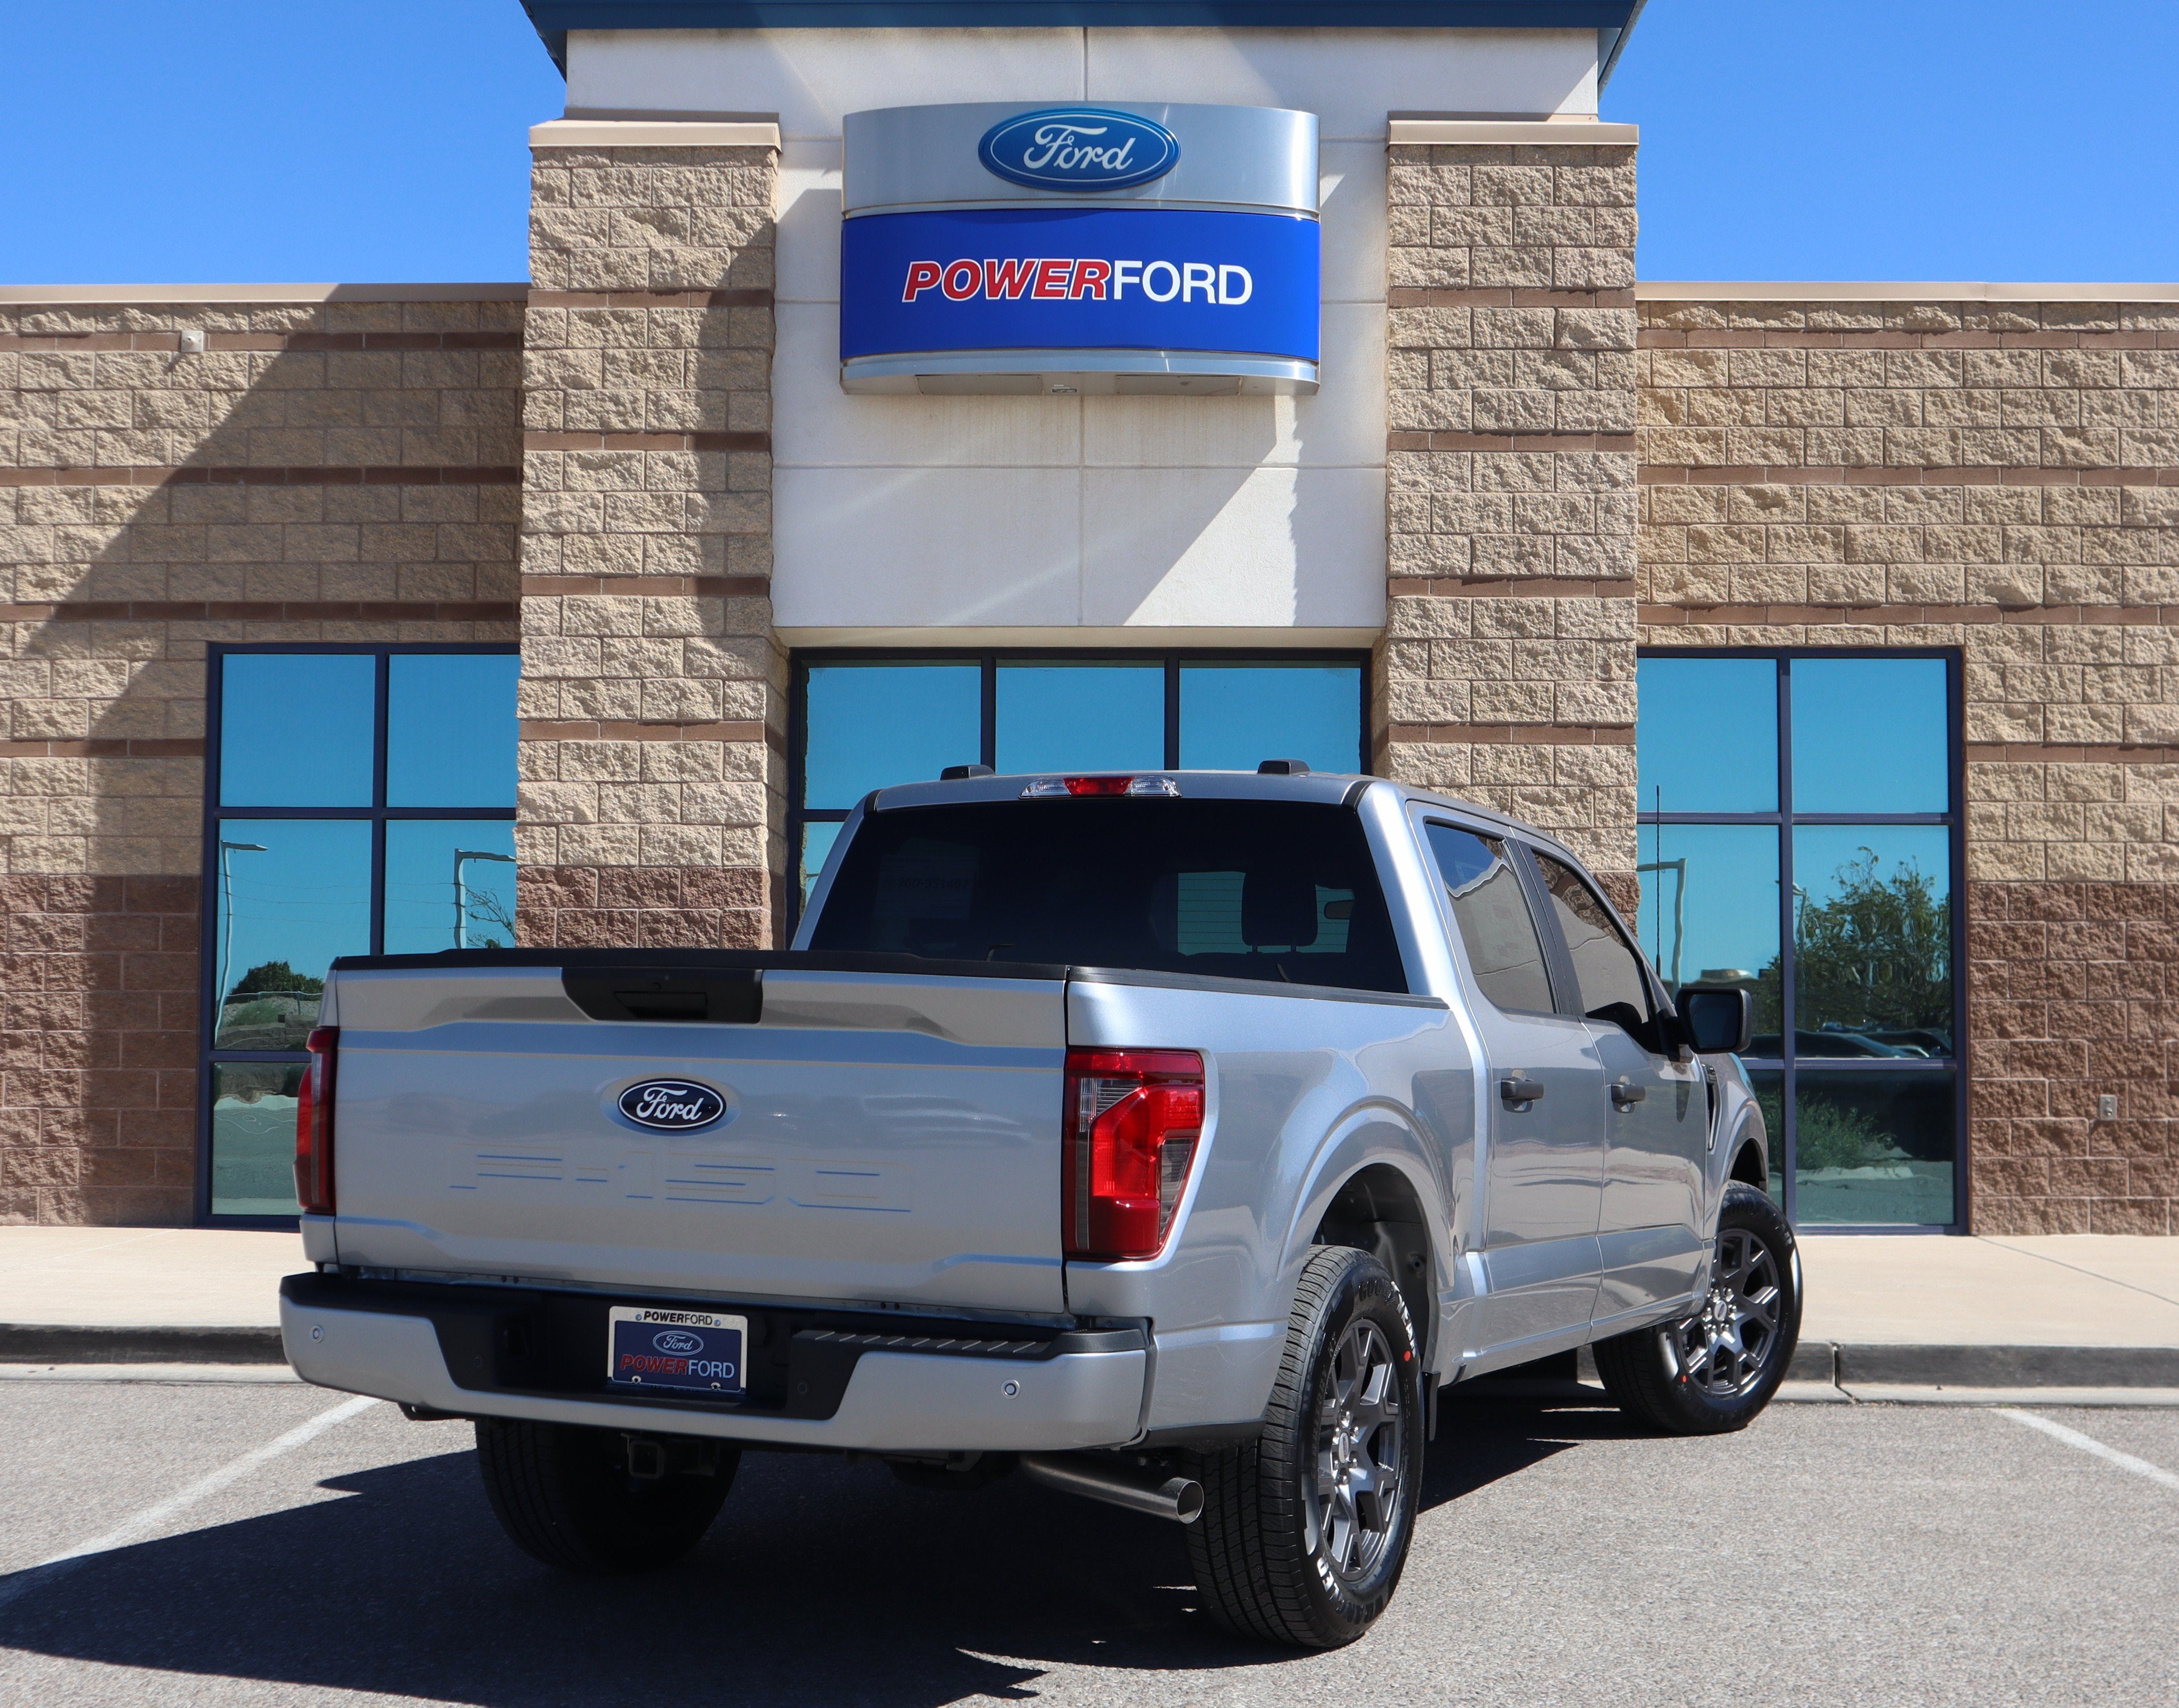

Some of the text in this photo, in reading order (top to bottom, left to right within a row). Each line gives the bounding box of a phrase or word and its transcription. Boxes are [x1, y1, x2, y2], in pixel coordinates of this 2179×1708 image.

[1023, 124, 1136, 170] Ford
[902, 258, 1252, 304] POWERFORD
[636, 1087, 704, 1121] Ford
[644, 1311, 712, 1325] POWERFORD
[663, 1335, 693, 1351] Ford
[620, 1354, 735, 1378] POWERFORD
